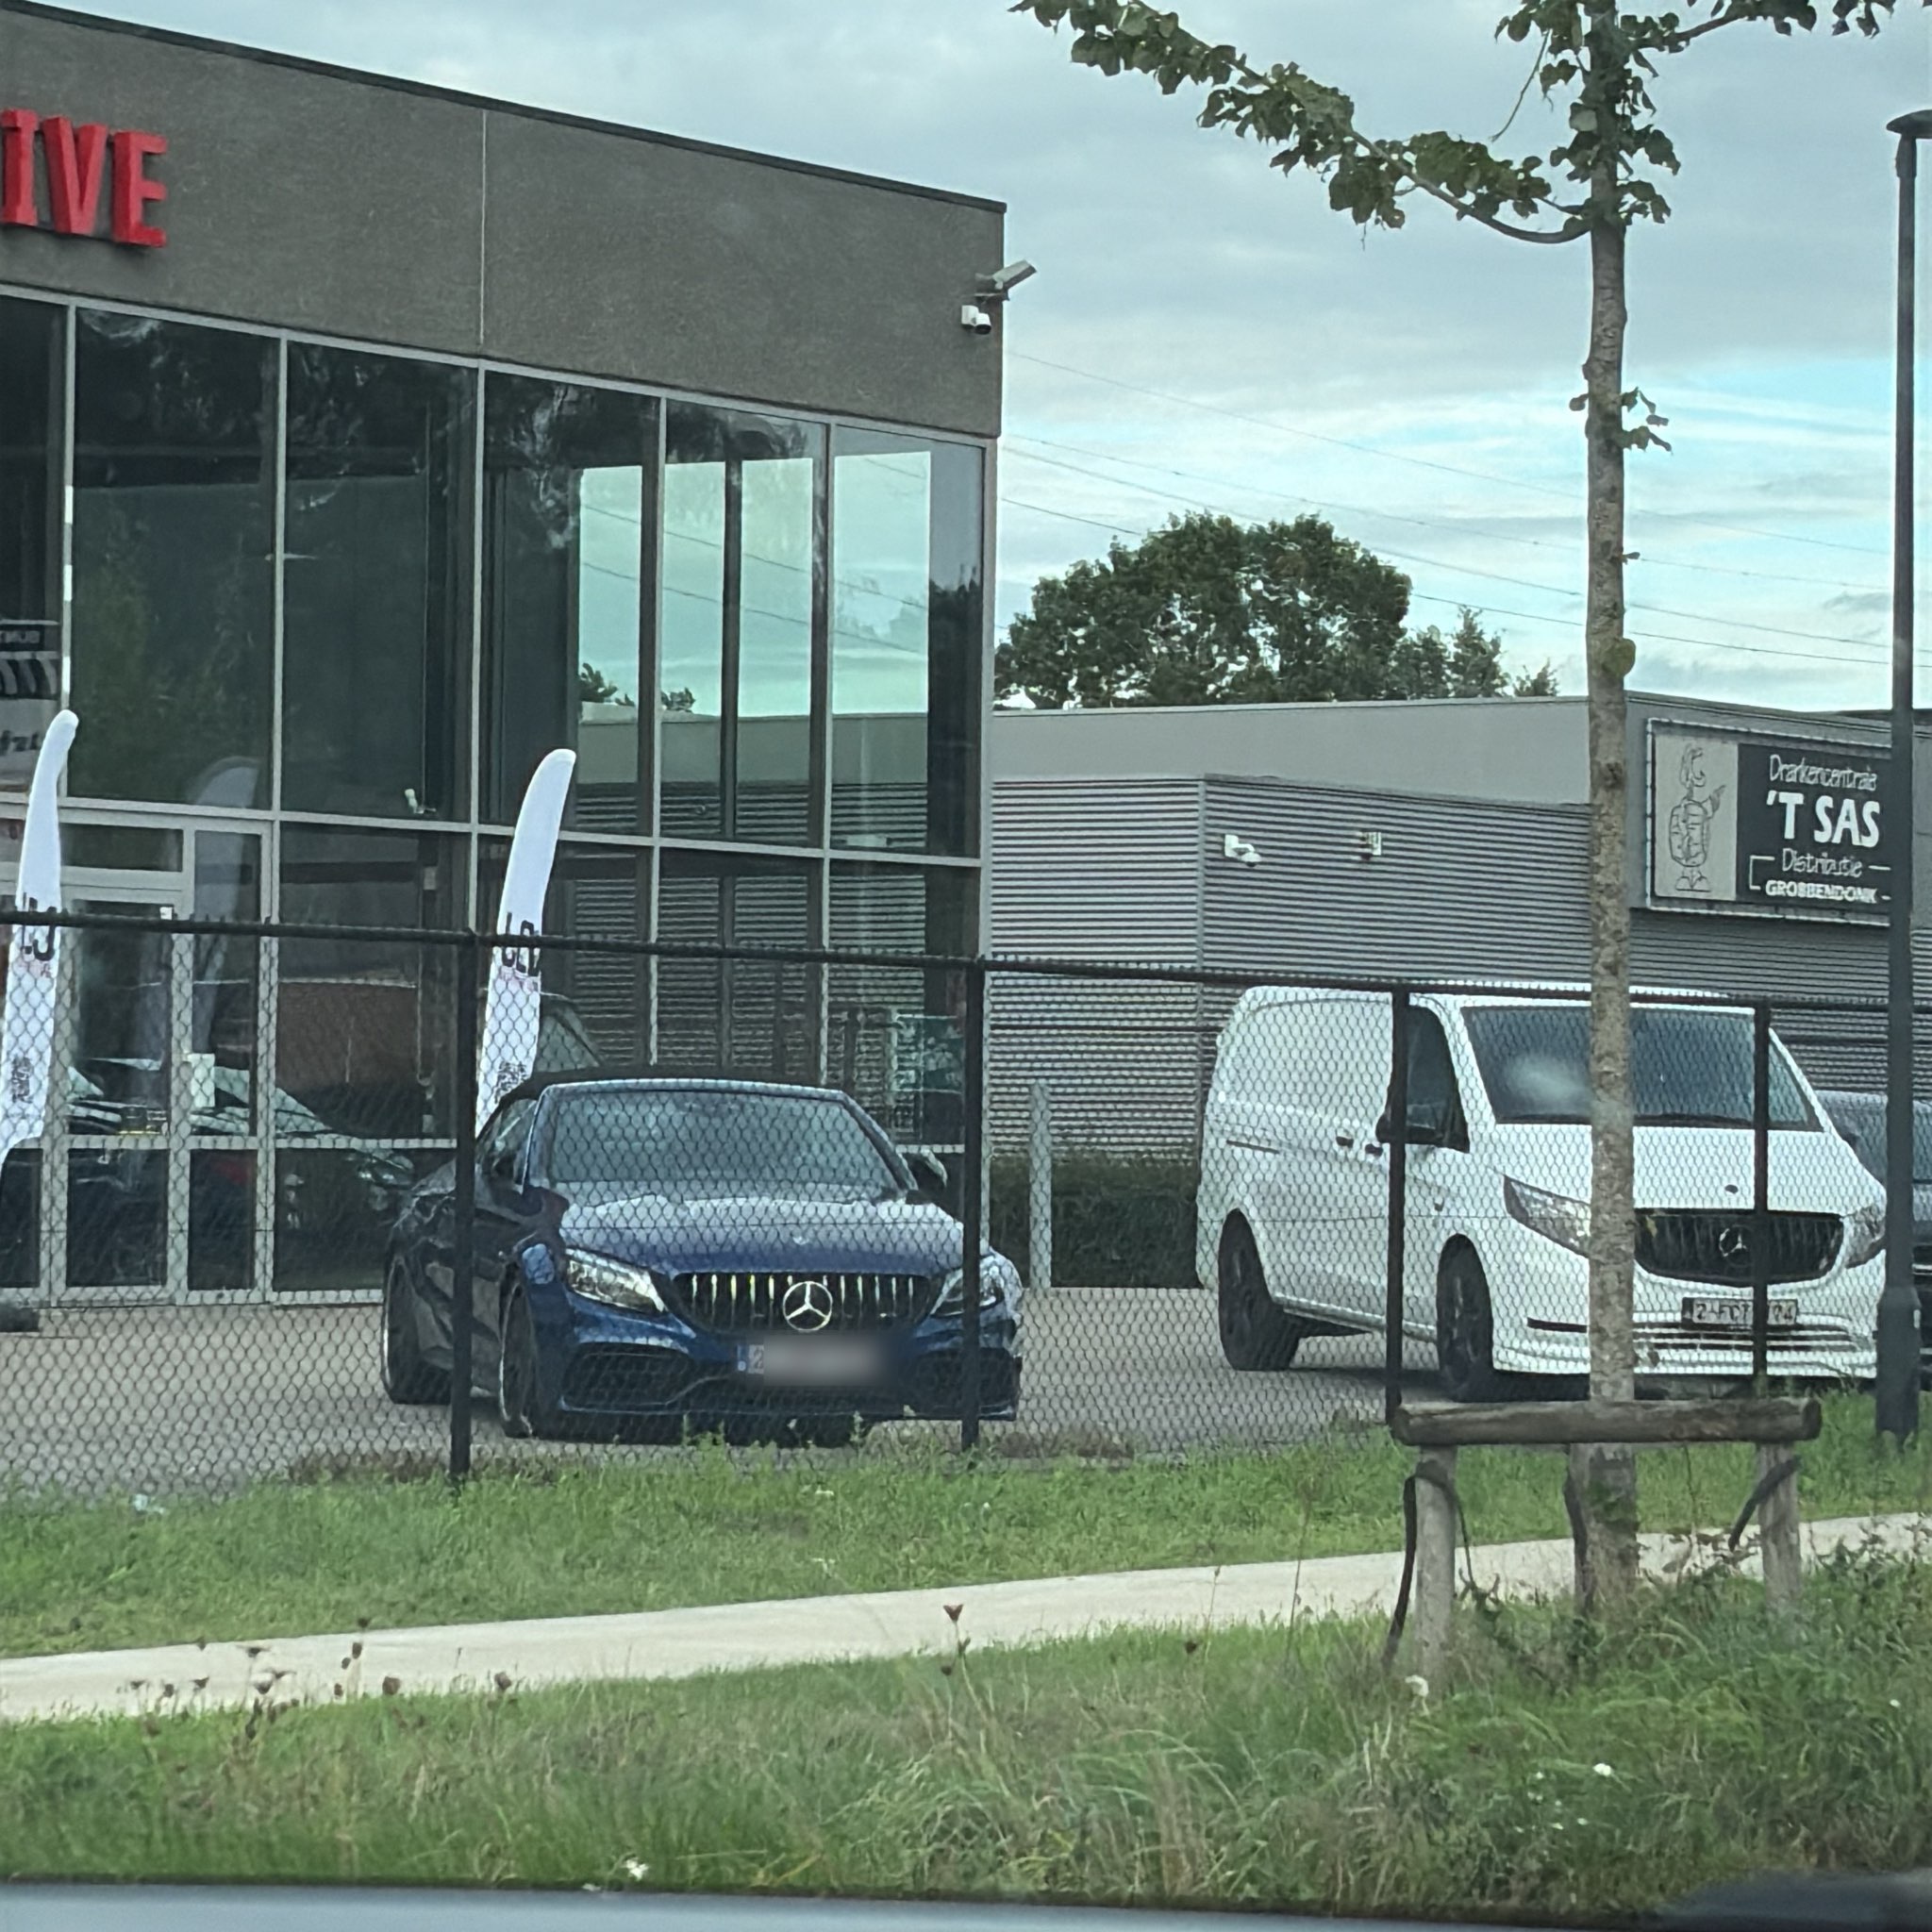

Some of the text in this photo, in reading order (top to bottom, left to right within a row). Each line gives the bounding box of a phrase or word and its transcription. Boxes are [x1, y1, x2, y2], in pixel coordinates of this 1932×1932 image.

[0, 108, 167, 247] IVE
[1767, 790, 1880, 847] 'T SAS
